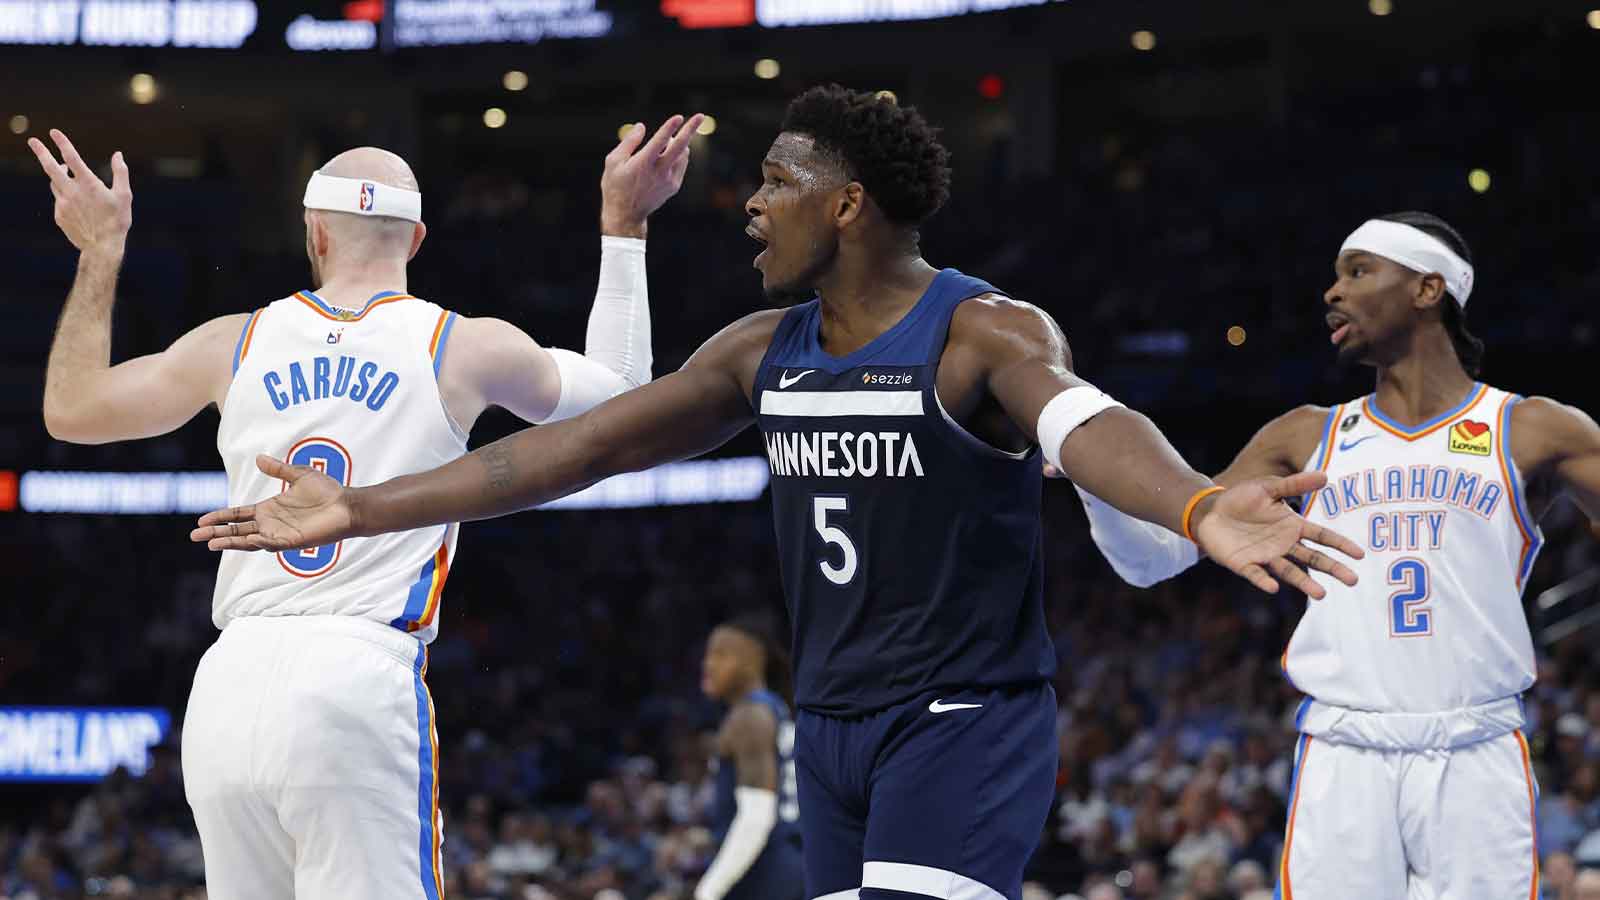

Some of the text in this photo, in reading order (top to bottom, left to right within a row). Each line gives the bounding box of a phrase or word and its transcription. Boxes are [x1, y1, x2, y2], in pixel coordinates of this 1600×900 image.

[263, 355, 399, 411] CARUSO
[871, 372, 913, 385] sezzle
[765, 431, 925, 478] MINNESOTA
[1320, 464, 1503, 520] OKLAHOMA
[813, 497, 858, 585] 5
[1368, 510, 1447, 552] CITY
[1388, 556, 1433, 637] 2
